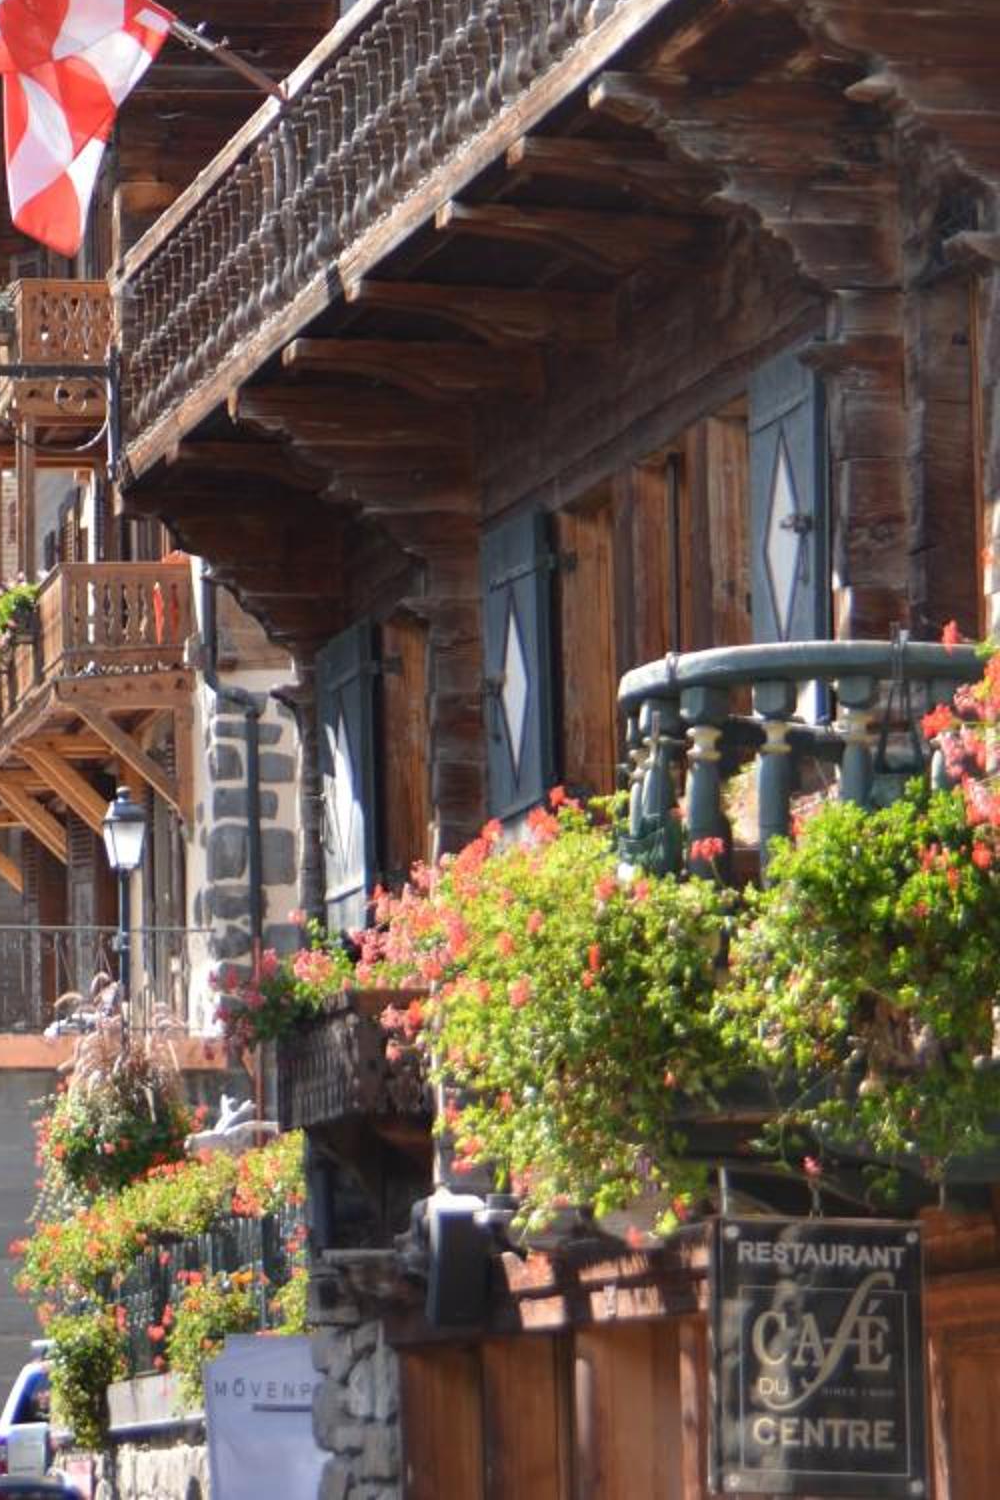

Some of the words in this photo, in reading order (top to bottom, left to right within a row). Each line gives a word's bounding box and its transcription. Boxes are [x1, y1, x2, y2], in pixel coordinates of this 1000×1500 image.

[736, 1241, 905, 1269] RESTAURANT
[759, 1377, 789, 1396] DU
[752, 1417, 896, 1449] CENTRE
